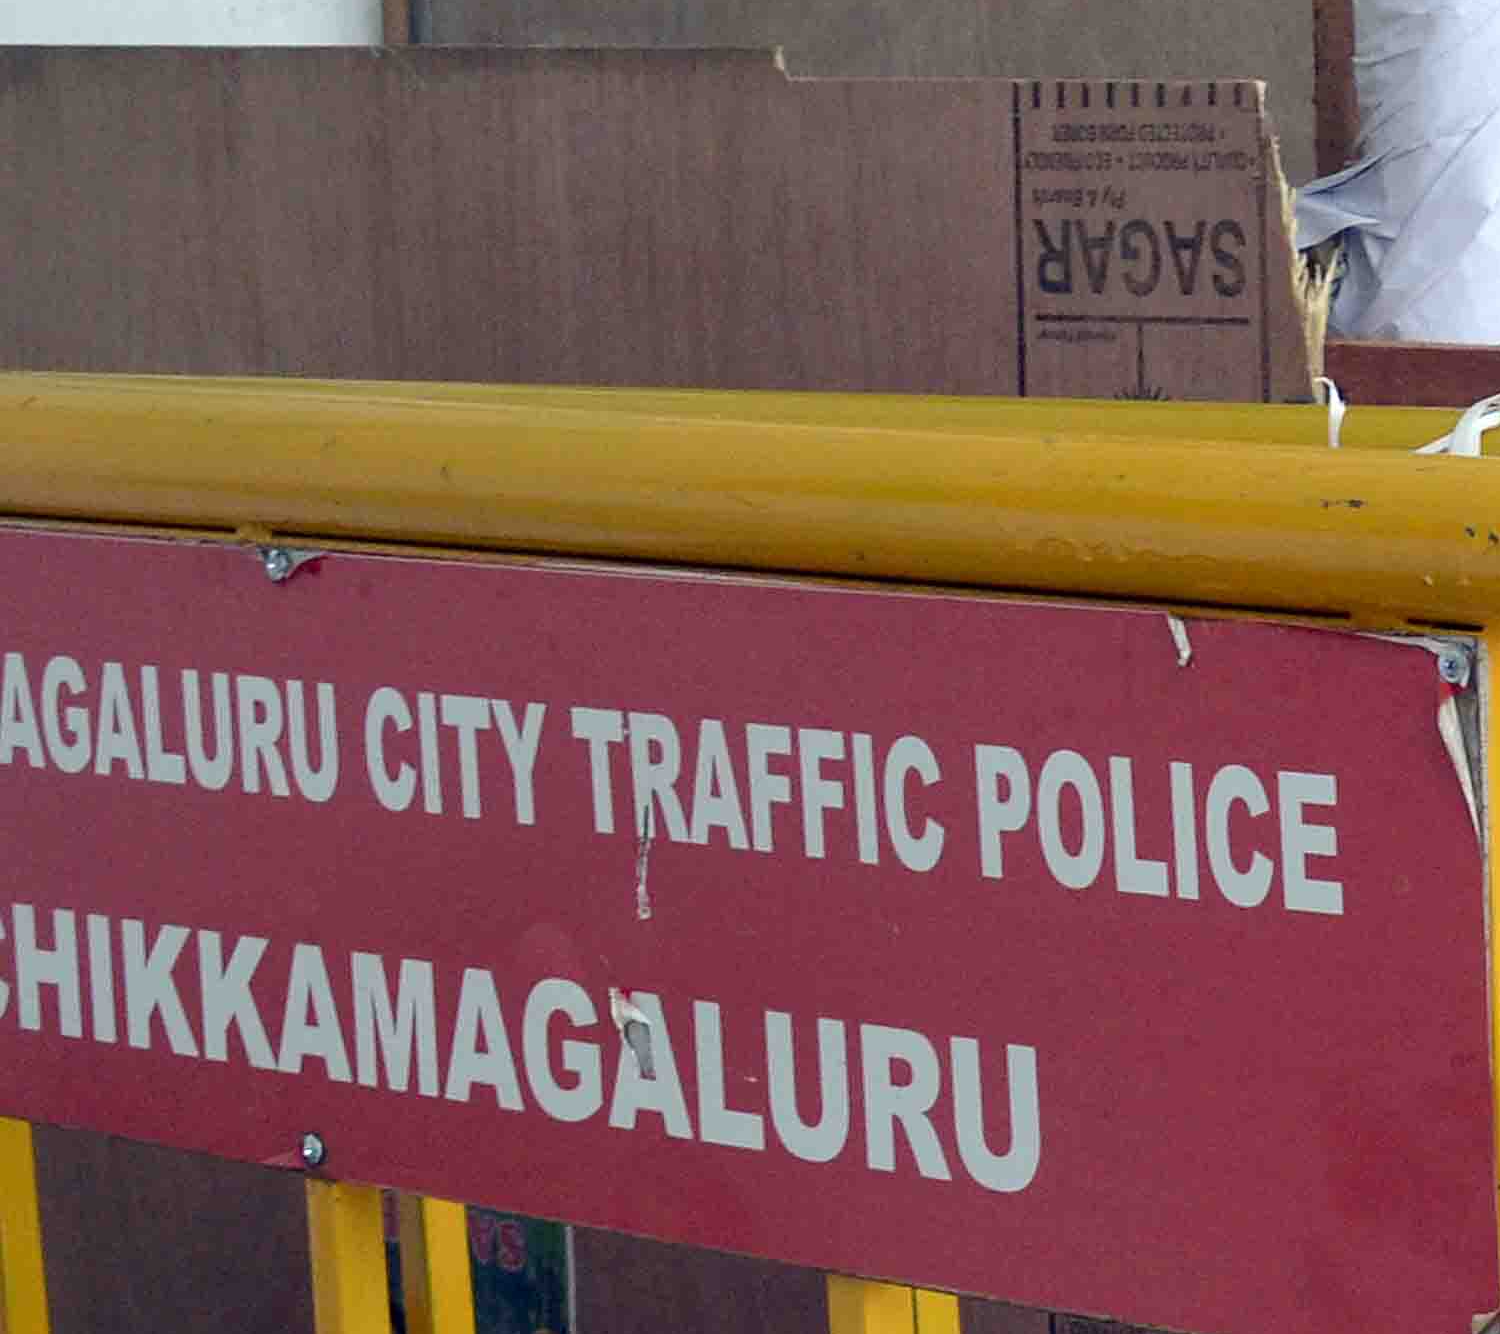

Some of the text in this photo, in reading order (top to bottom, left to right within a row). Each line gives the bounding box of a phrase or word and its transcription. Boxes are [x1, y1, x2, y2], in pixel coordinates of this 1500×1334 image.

[1033, 217, 1248, 298] SAGAR
[364, 686, 546, 827] CITY
[569, 706, 945, 872] TRAFFIC
[976, 744, 1344, 915] POLICE
[0, 903, 1041, 1192] HIKKAMAGALURU
